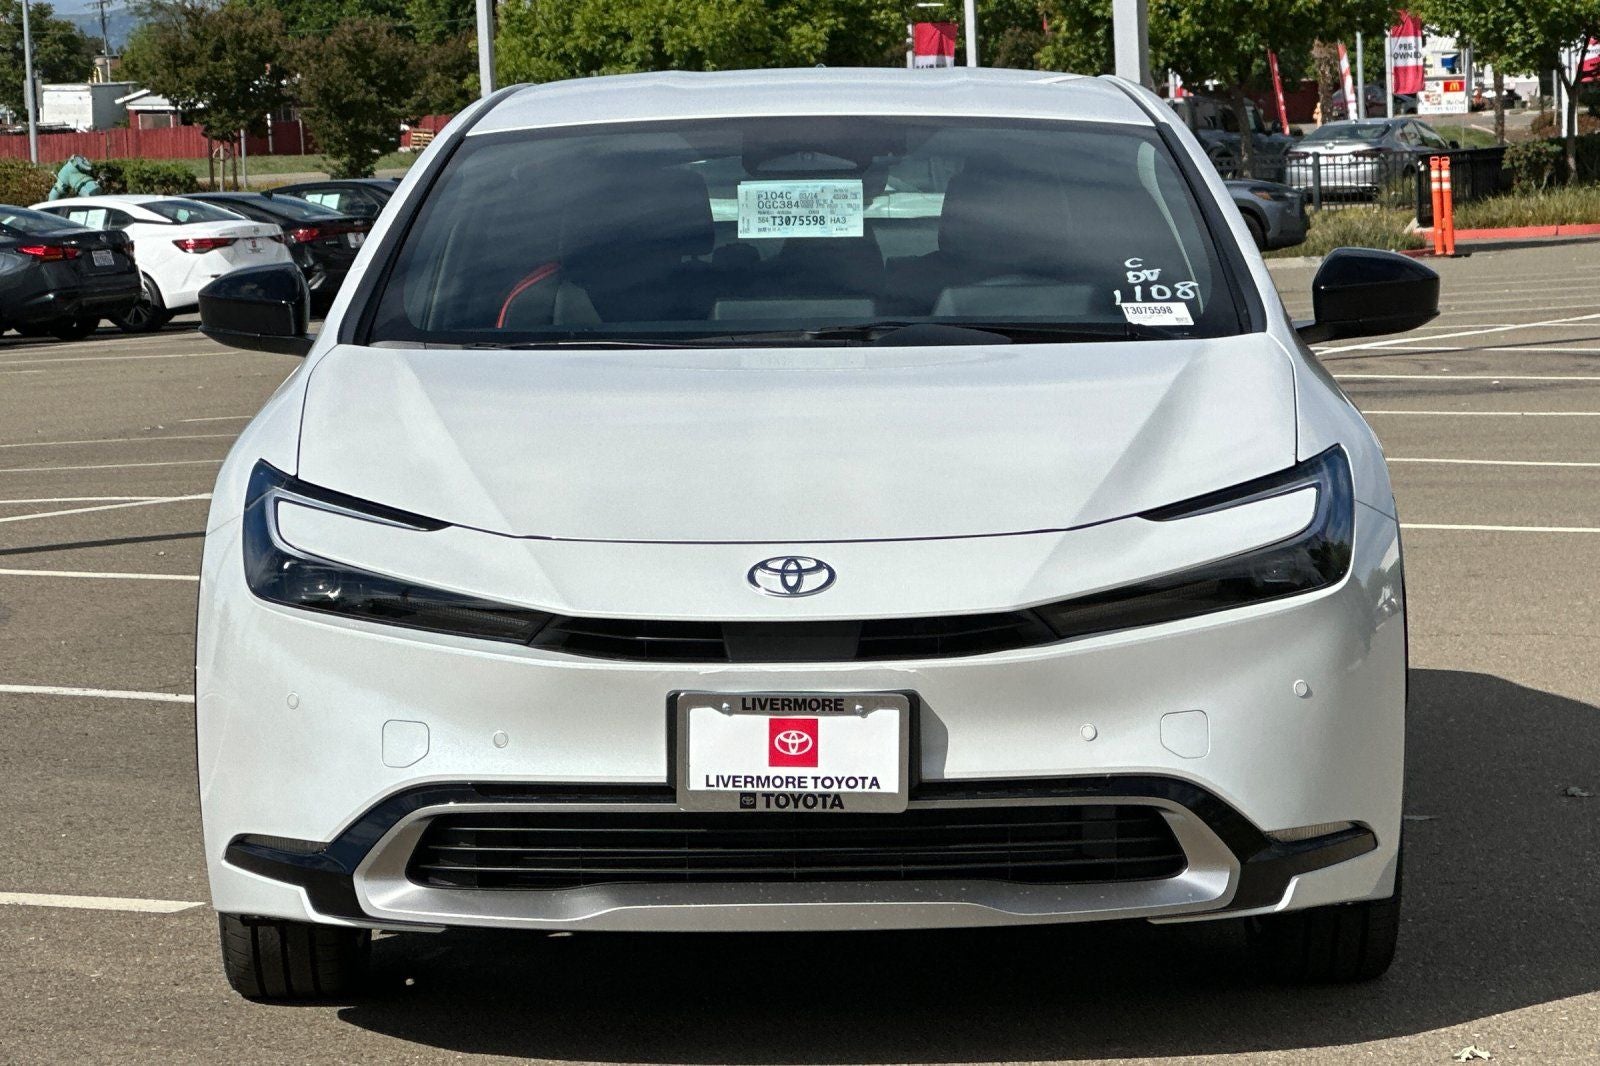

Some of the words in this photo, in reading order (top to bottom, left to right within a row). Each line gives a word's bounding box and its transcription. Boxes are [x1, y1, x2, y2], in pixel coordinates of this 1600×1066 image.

[770, 215, 826, 226] T3075598
[1124, 306, 1173, 315] T3075598
[741, 697, 845, 713] LIVERMORE
[705, 775, 808, 789] LIVERMORE
[811, 775, 881, 790] TOYOTA
[761, 793, 845, 810] TOYOTA
